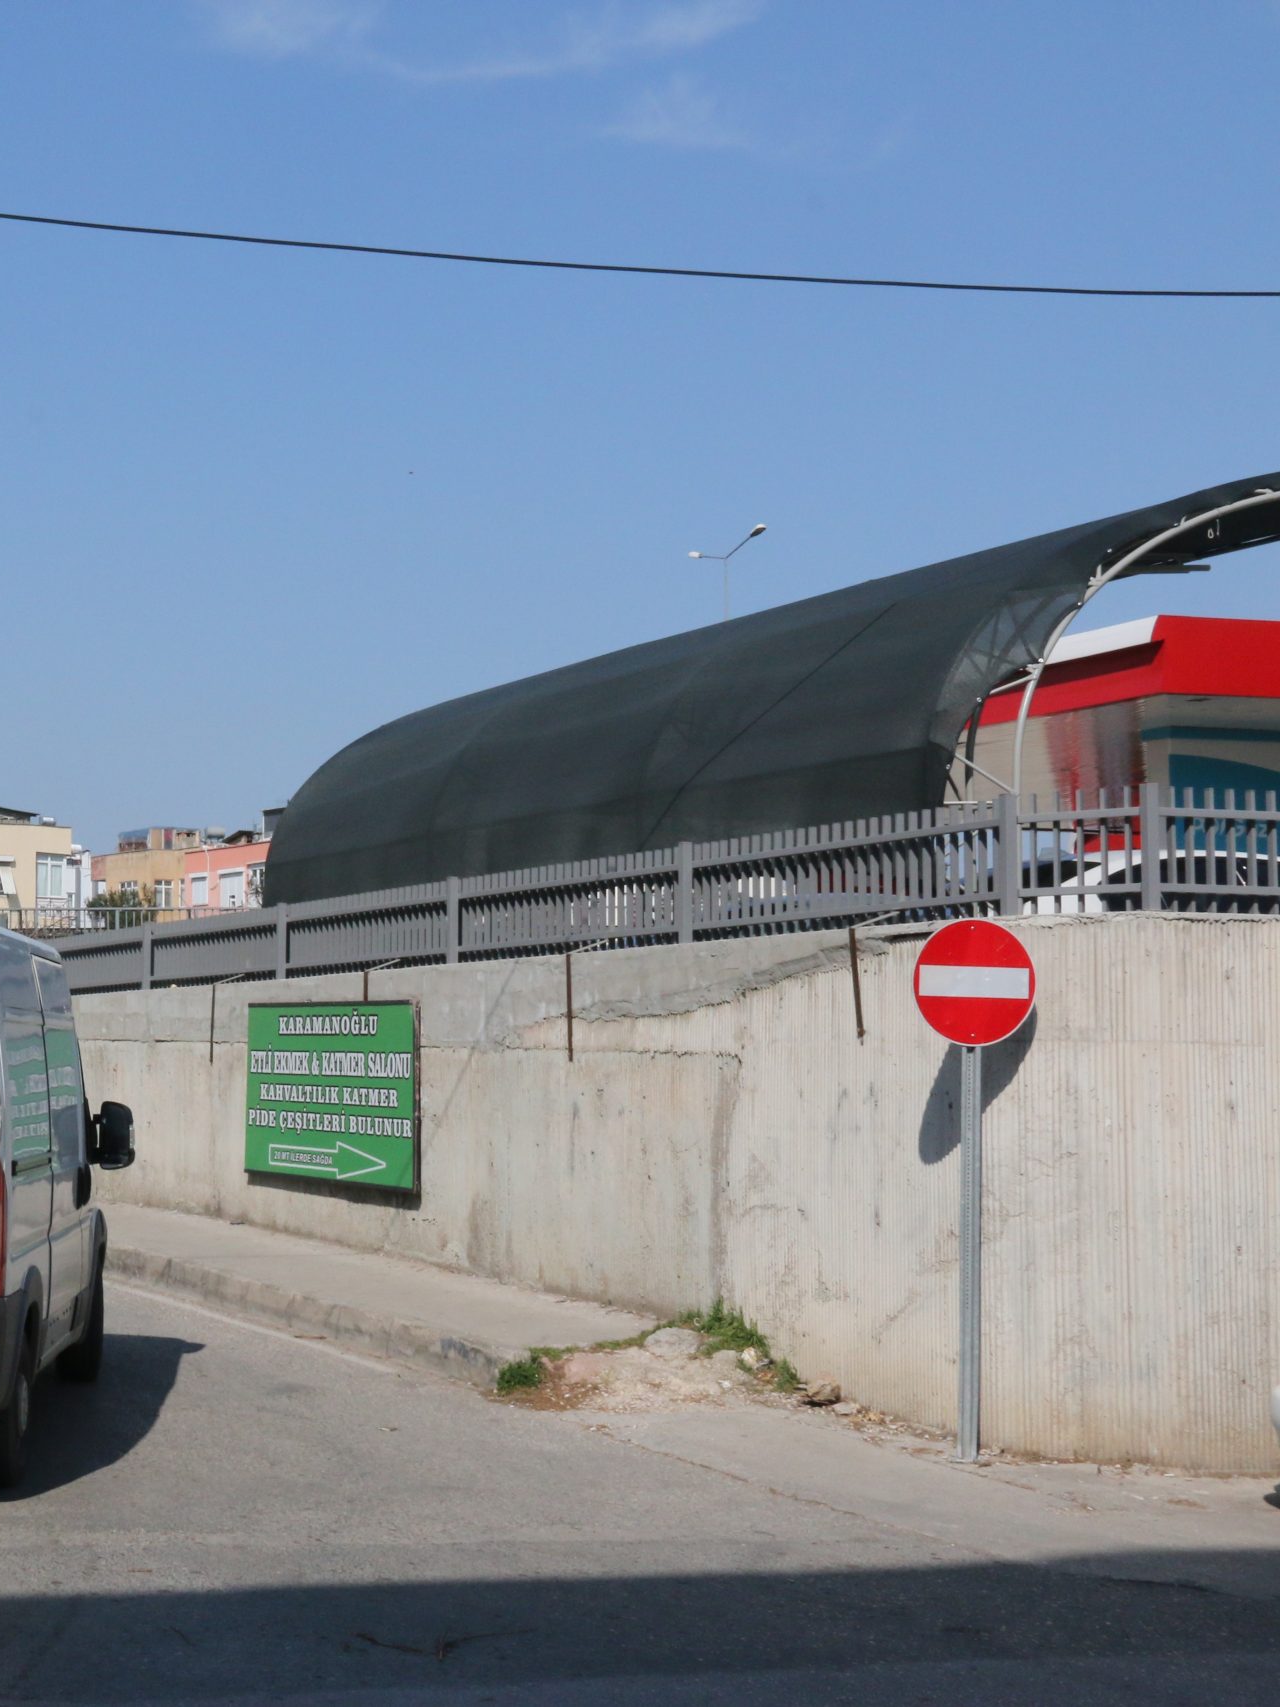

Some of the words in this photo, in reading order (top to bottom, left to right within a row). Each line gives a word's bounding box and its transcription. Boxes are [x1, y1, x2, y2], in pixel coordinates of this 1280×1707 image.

[278, 1009, 378, 1036] KARAMANOĞLU
[250, 1044, 272, 1074] ETLİ
[273, 1050, 310, 1075] EKMEK
[311, 1052, 320, 1076] &
[321, 1051, 366, 1077] KATMER
[367, 1053, 412, 1079] SALONU
[260, 1083, 340, 1104] KAHVALTILIK
[342, 1087, 399, 1108] KATMER
[248, 1105, 276, 1127] PİDE
[279, 1108, 346, 1135] ÇEŞİTLERİ
[349, 1115, 413, 1138] BULUNUR
